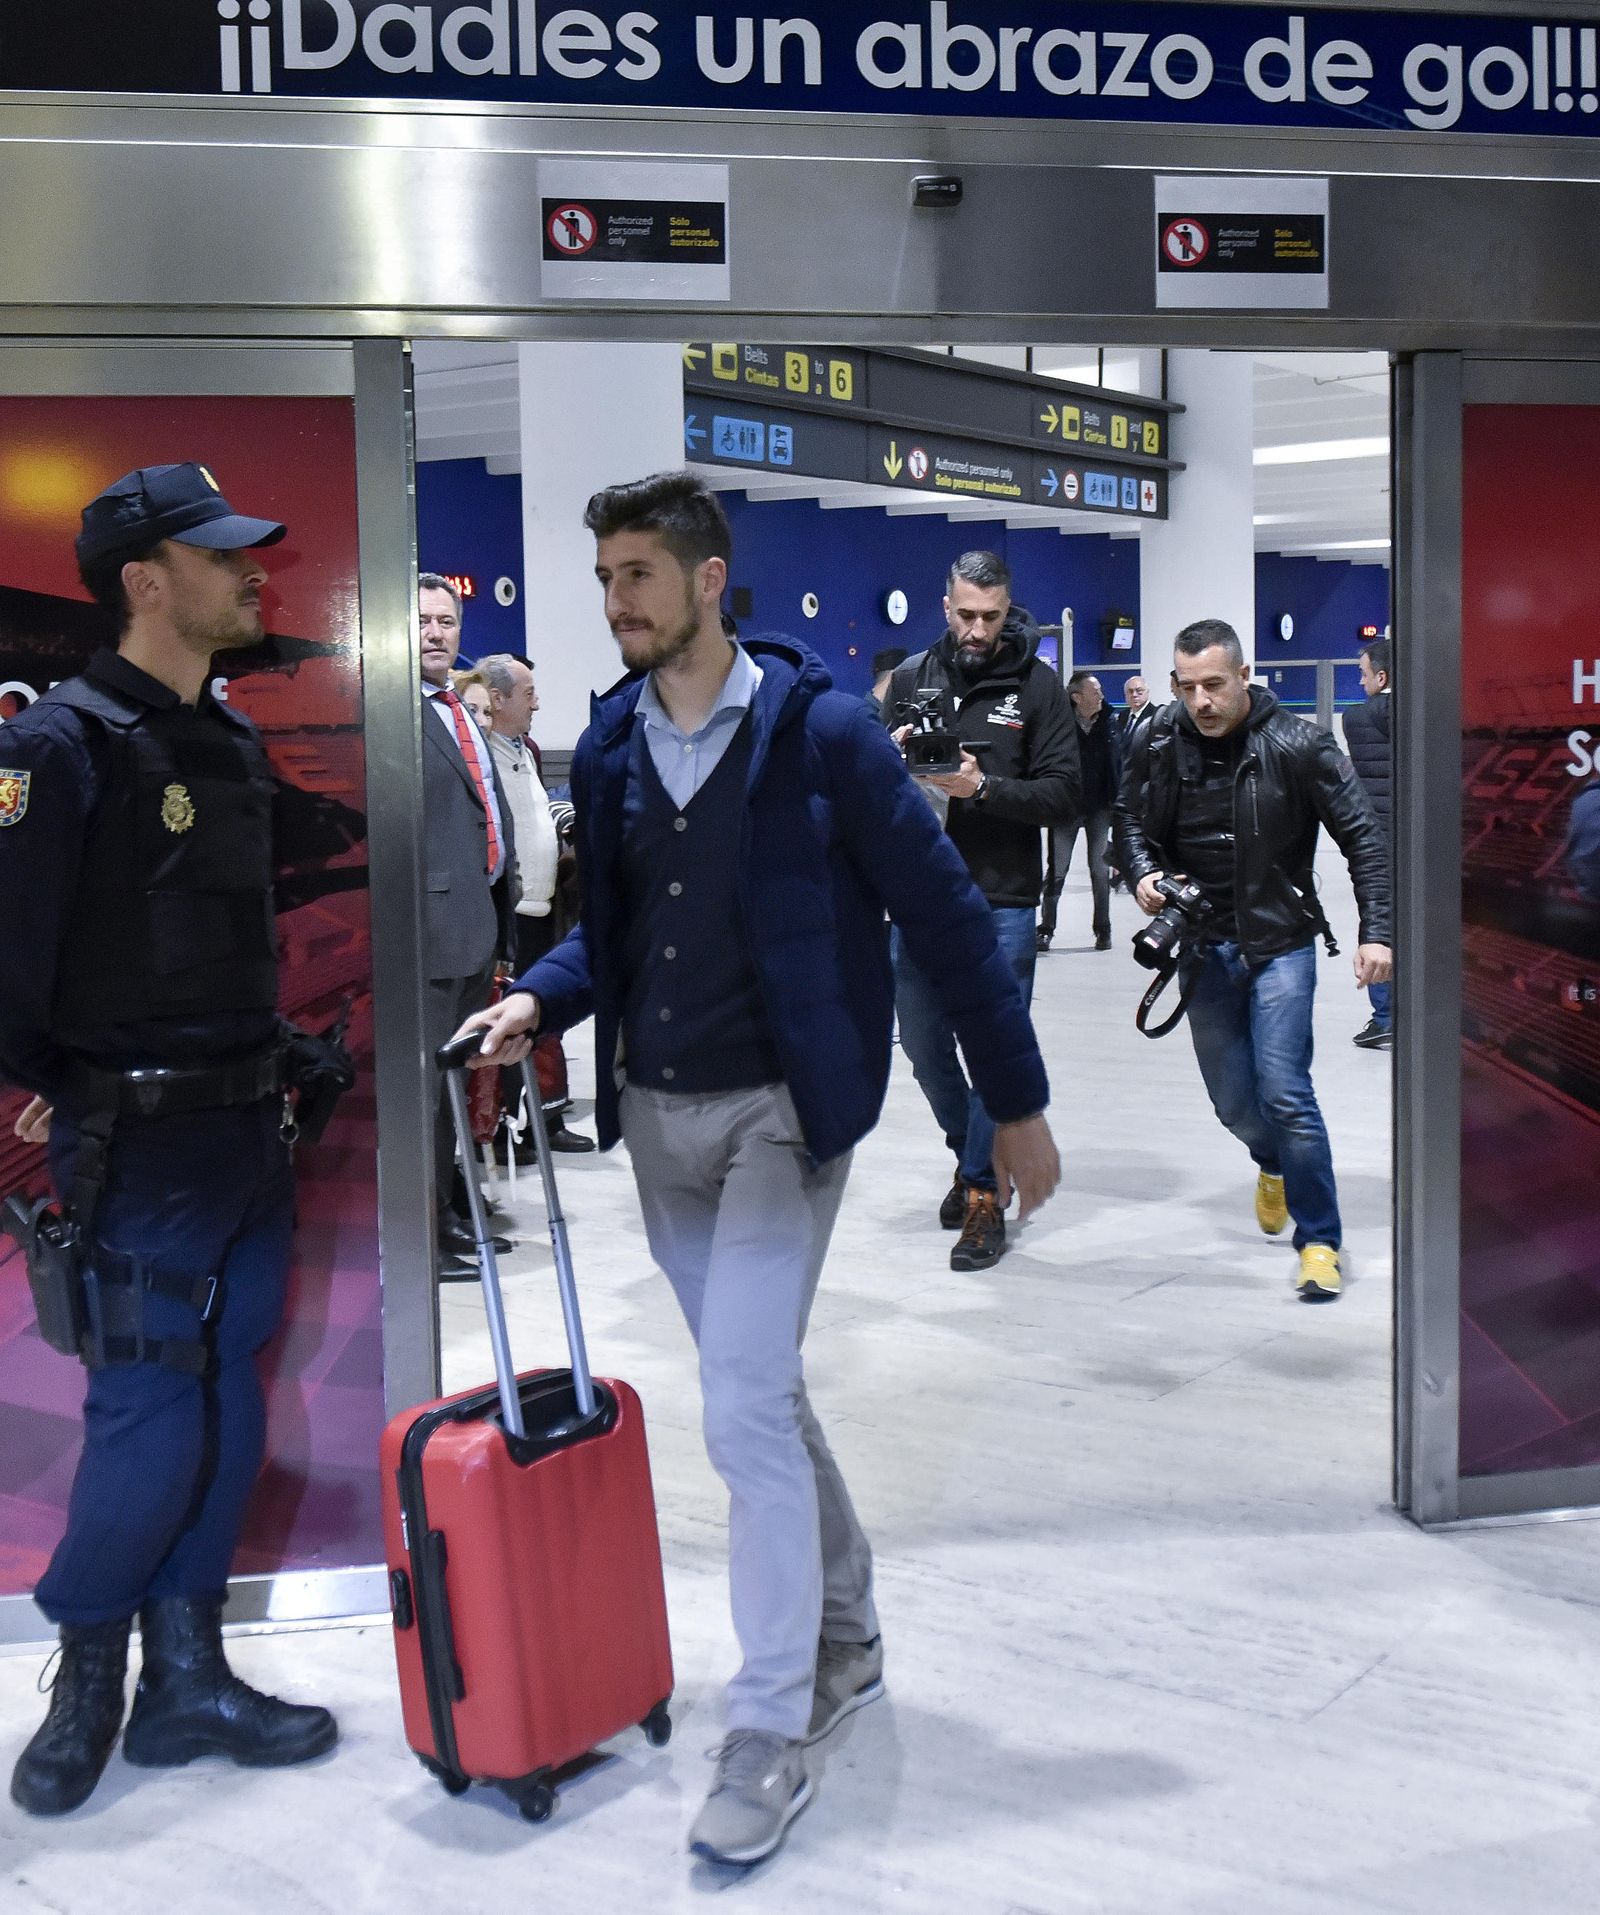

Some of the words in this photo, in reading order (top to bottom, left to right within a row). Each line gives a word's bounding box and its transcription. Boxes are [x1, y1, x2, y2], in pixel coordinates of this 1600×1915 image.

[696, 15, 822, 85] un
[856, 1, 1214, 100] abrazo
[1244, 16, 1374, 104] de
[1403, 26, 1599, 130] gol!!
[608, 215, 653, 225] Authorized
[608, 226, 650, 237] personnel
[670, 227, 711, 238] personal
[1218, 229, 1260, 237] Authorized
[608, 237, 626, 247] only
[670, 238, 720, 247] autorizado
[1218, 238, 1258, 248] personnel
[1274, 239, 1312, 249] personal
[744, 345, 768, 365] Belts
[791, 359, 803, 385] 3
[814, 360, 824, 375] to
[835, 368, 847, 393] 6
[744, 366, 780, 388] Cintas
[815, 384, 823, 395] a
[1084, 410, 1100, 427] Belts
